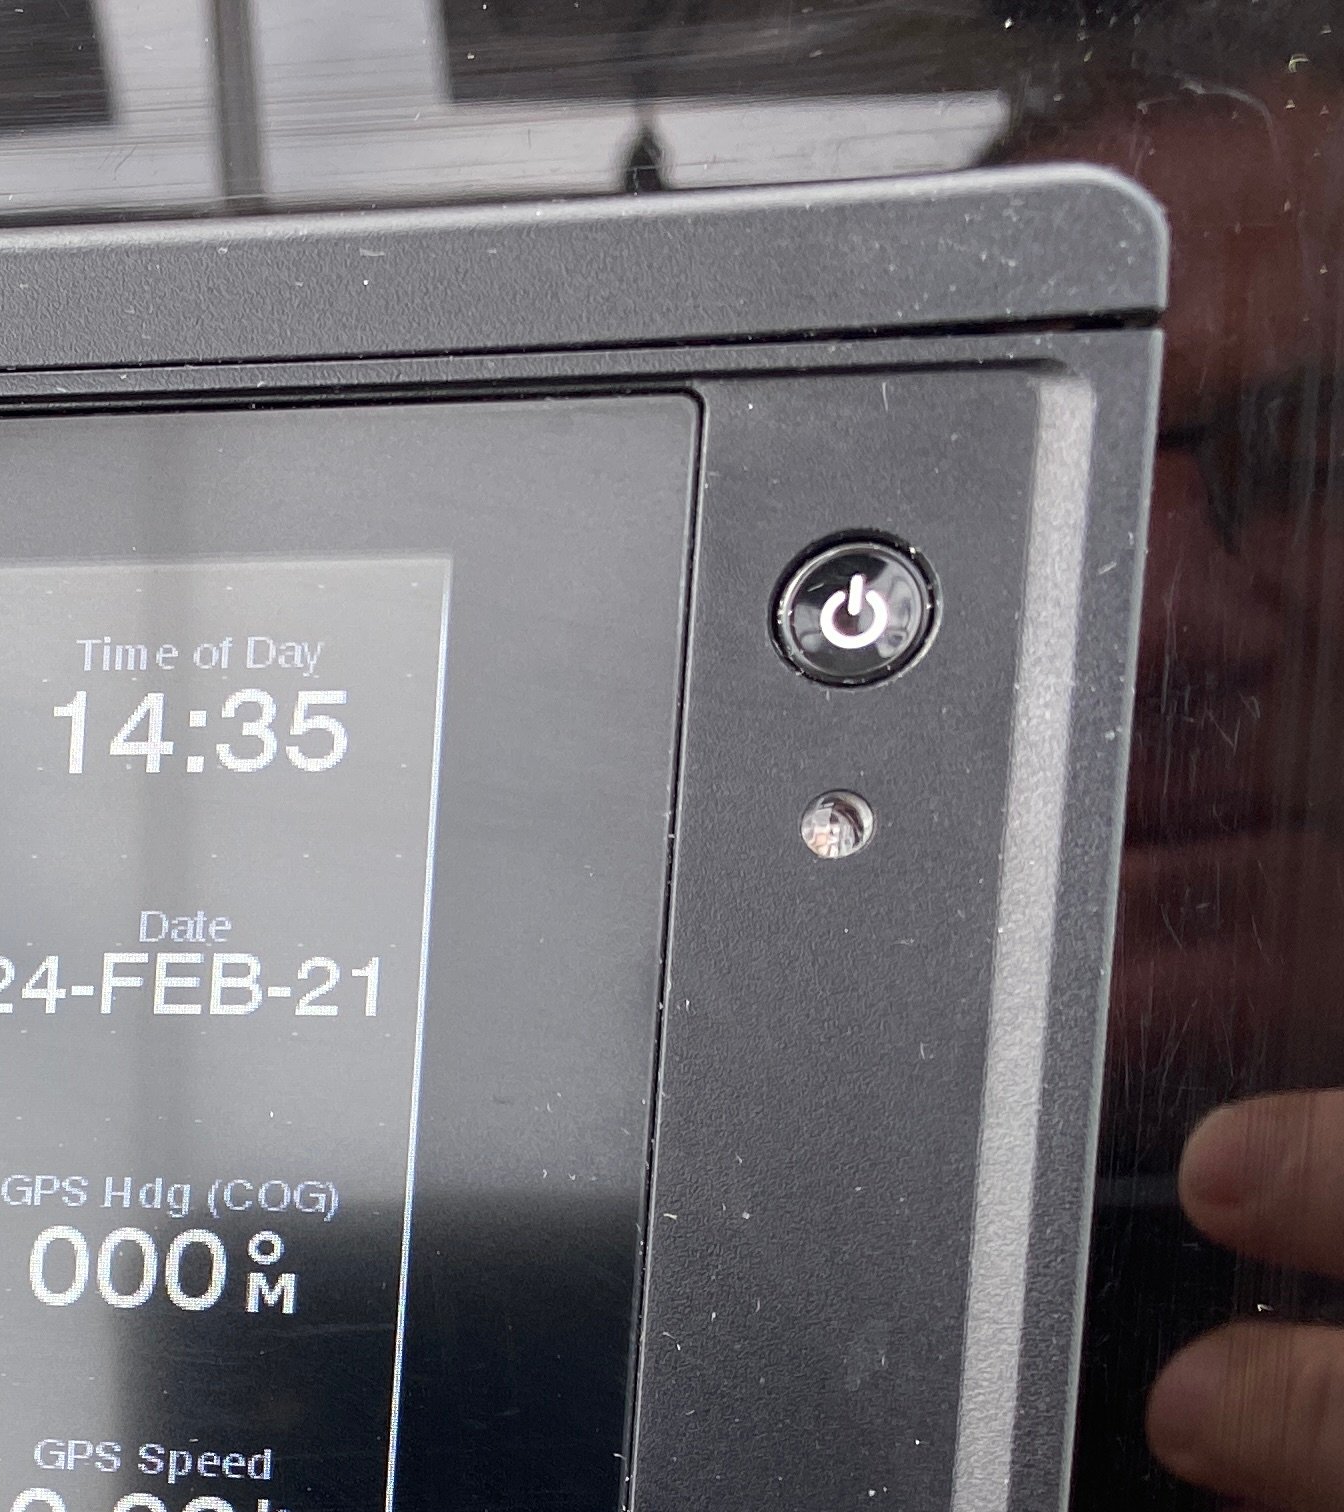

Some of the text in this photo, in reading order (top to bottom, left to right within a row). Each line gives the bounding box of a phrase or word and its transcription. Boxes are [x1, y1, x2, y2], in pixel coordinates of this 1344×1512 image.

[75, 636, 326, 676] Time of Day
[52, 688, 348, 774] 14:35
[138, 909, 233, 943] Date
[0, 1175, 340, 1222] GPS Hdg (COG)
[28, 1225, 227, 1312] 000
[33, 1438, 274, 1484] GPS Speed
